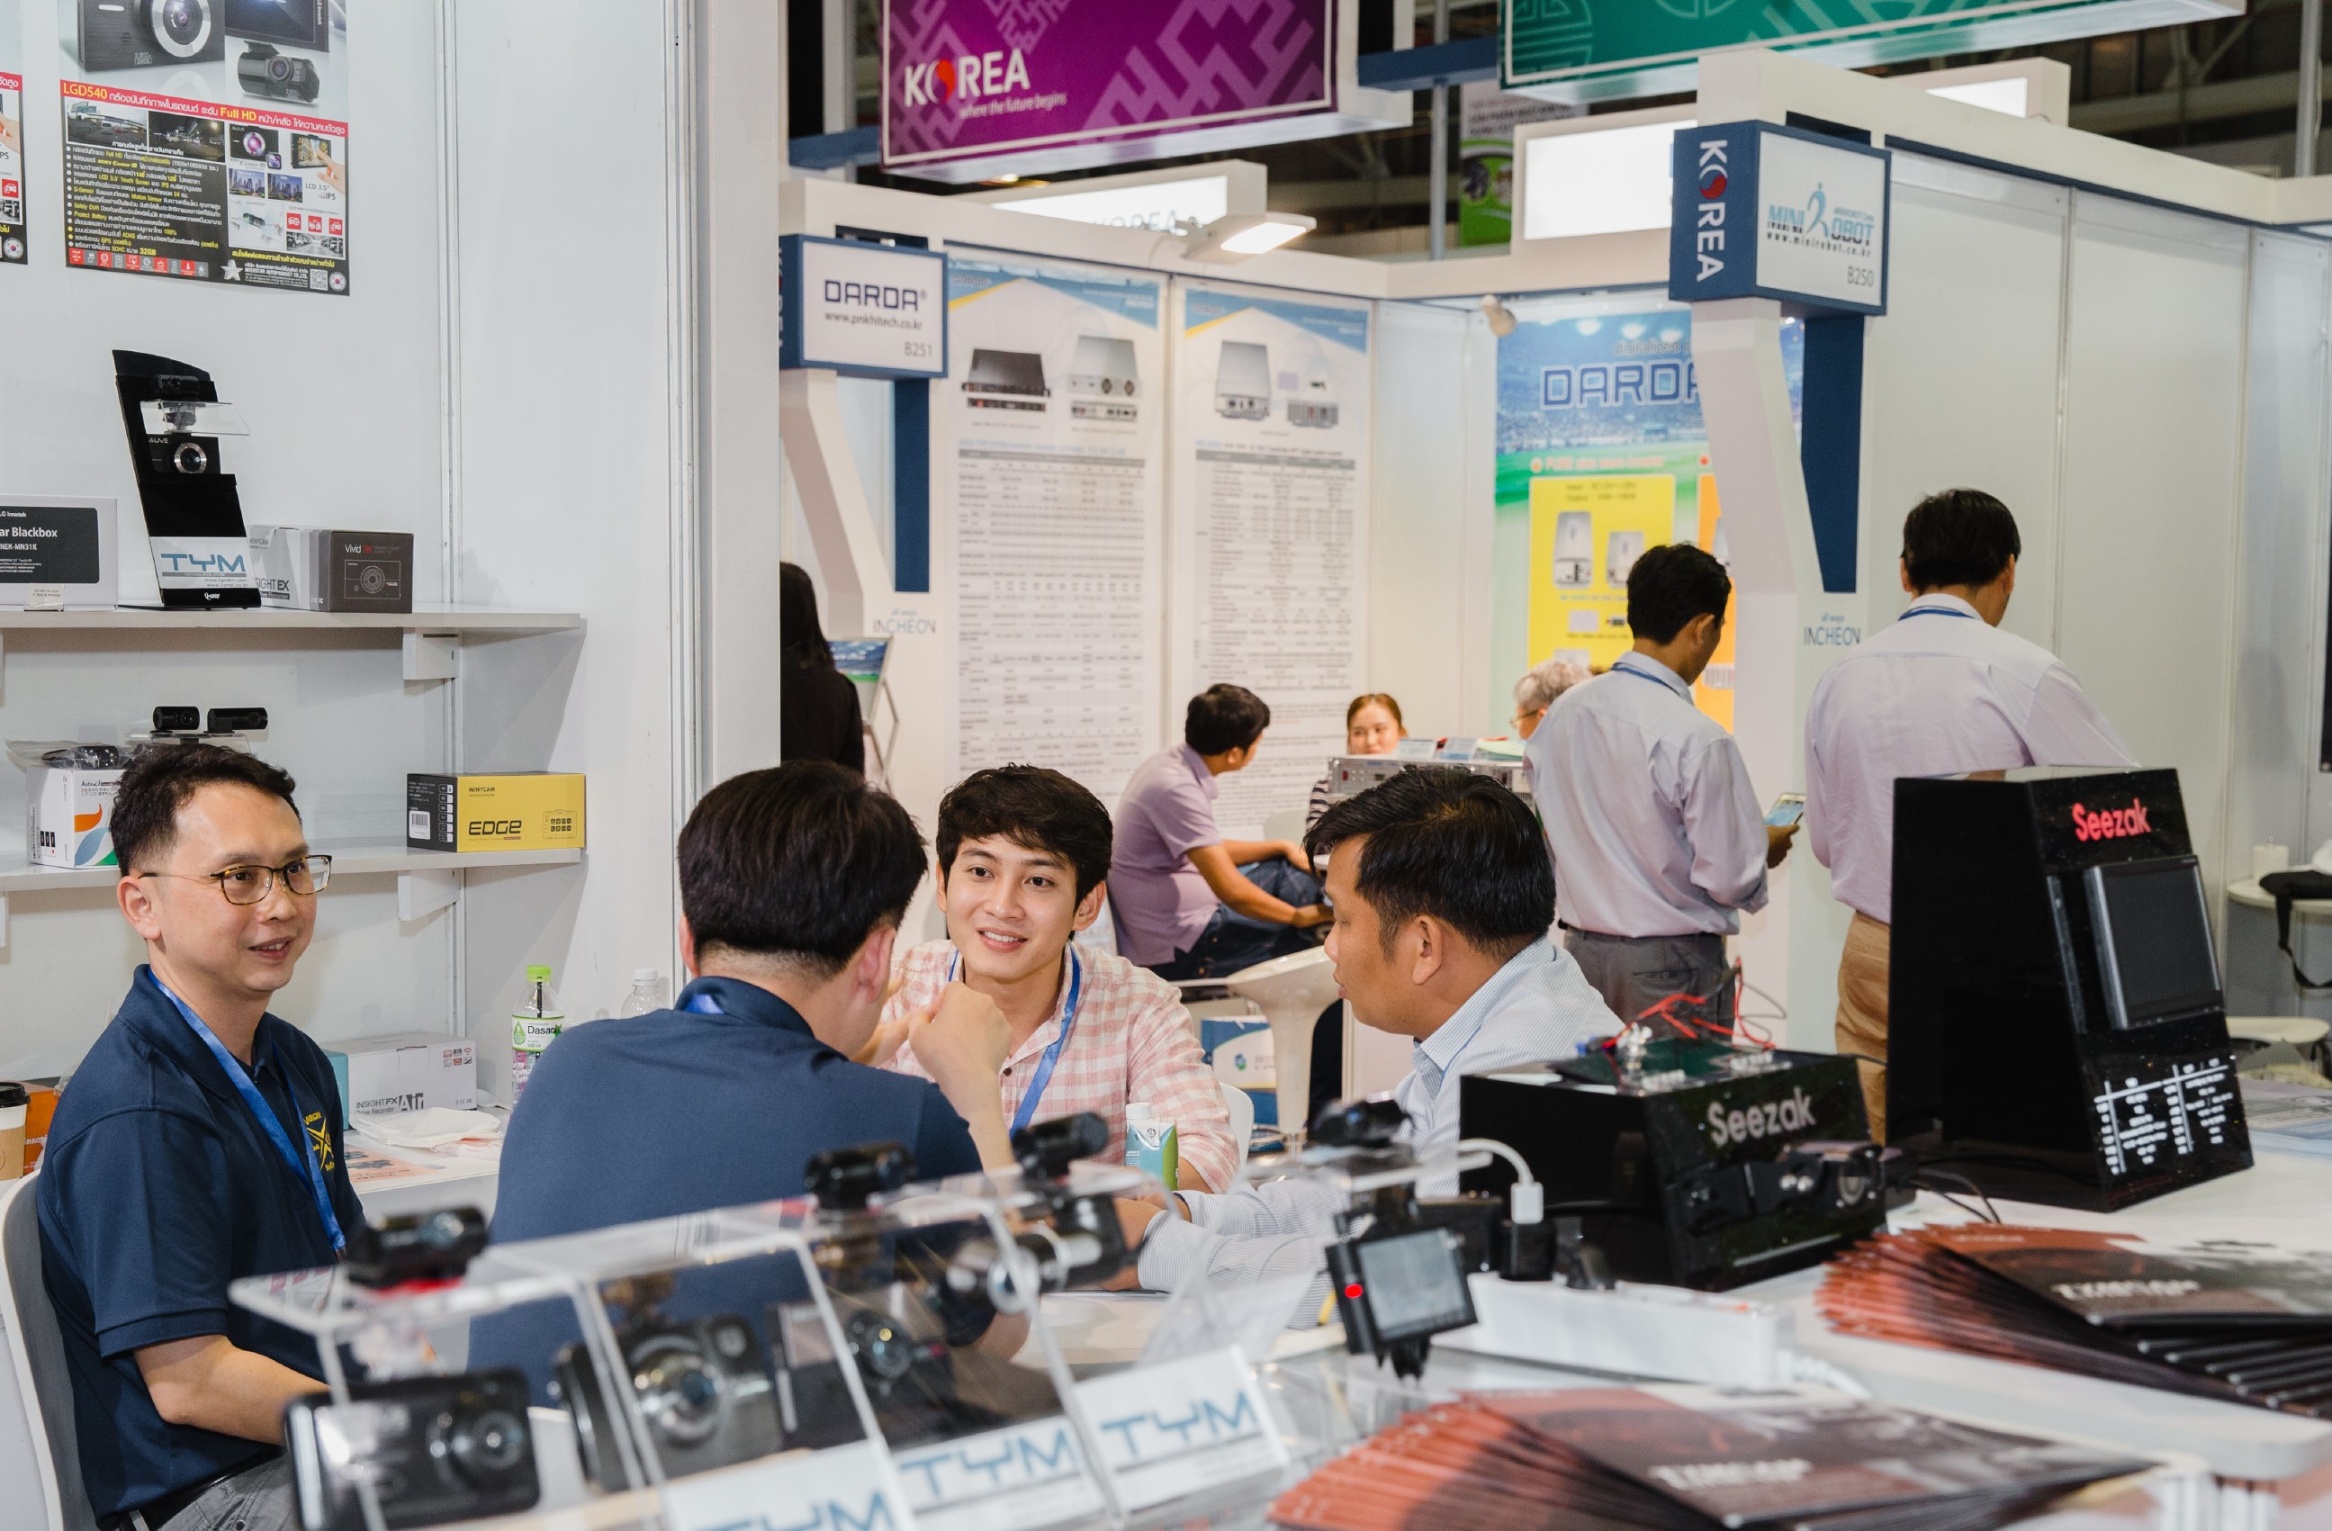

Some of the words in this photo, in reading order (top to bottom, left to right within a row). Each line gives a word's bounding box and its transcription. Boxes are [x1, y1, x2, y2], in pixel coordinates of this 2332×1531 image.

[904, 48, 1031, 108] KOREA
[63, 82, 107, 100] LGD540
[220, 106, 238, 118] Full
[241, 110, 257, 121] HD
[960, 103, 987, 119] where
[989, 99, 1003, 116] the
[1006, 95, 1033, 114] future
[1034, 92, 1068, 111] begins
[305, 182, 317, 190] LCD
[1696, 139, 1728, 283] KOREA
[139, 247, 157, 256] 32GB
[1847, 265, 1875, 288] B250
[904, 341, 933, 358] B251
[12, 526, 58, 538] Blackbox
[344, 544, 362, 554] Vivid
[161, 553, 246, 573] TYM
[277, 579, 290, 592] EX
[872, 618, 937, 635] INCHEON
[1803, 626, 1862, 646] INCHEON
[2071, 797, 2152, 842] Seezak
[399, 1092, 424, 1112] Air
[1706, 1086, 1816, 1148] Seezak
[1102, 1391, 1259, 1459] TYM
[896, 1430, 1079, 1496] TYM
